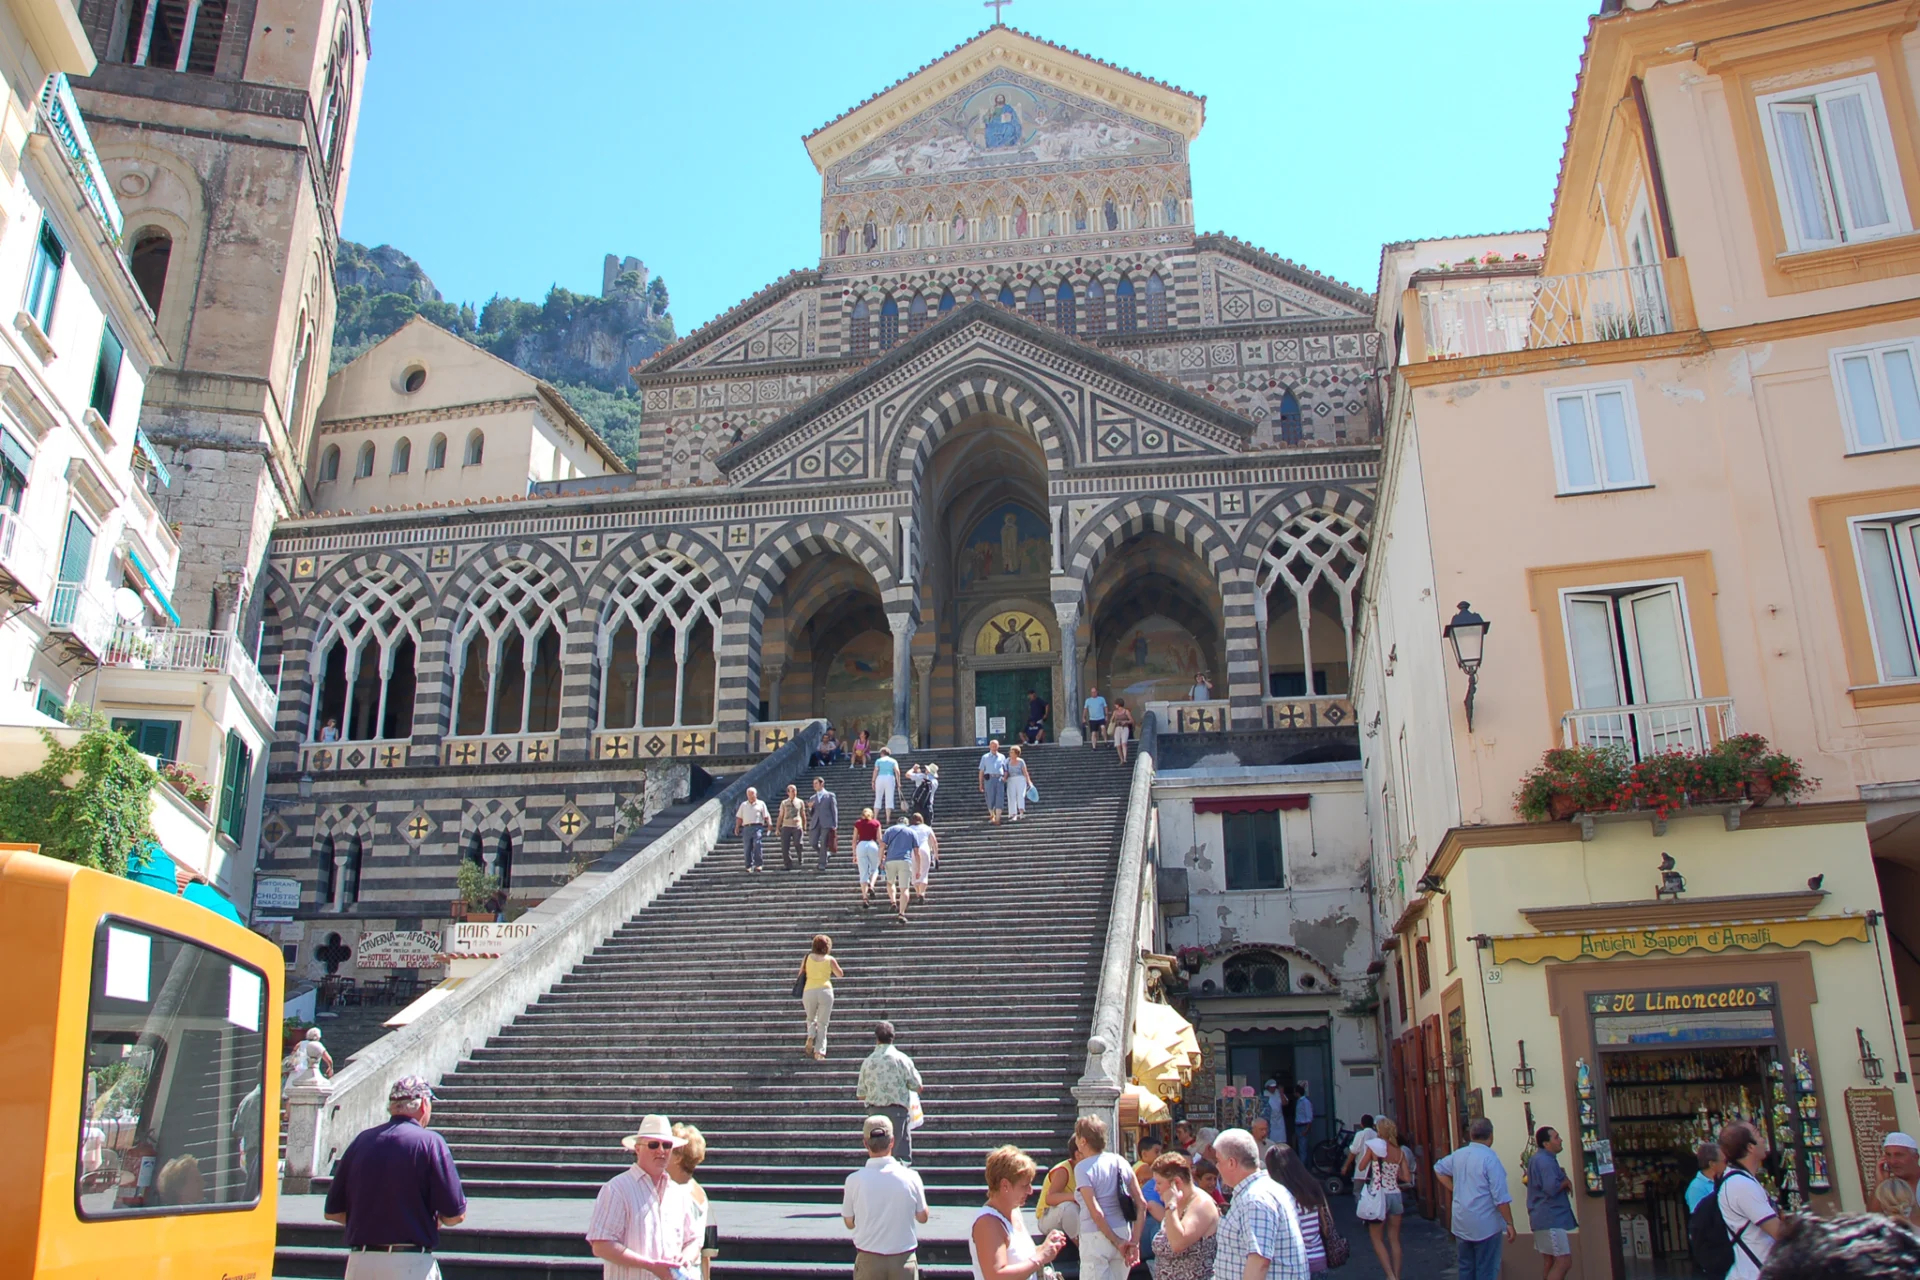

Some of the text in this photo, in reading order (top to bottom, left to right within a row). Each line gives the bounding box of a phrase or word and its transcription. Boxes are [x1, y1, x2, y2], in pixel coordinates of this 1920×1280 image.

[361, 931, 396, 952] TAVERNA
[457, 924, 490, 938] HAIR
[1580, 927, 1771, 954] Antichi Sapori d'Amalfi
[1488, 971, 1500, 981] 39
[1612, 988, 1757, 1013] Il Limoncello
